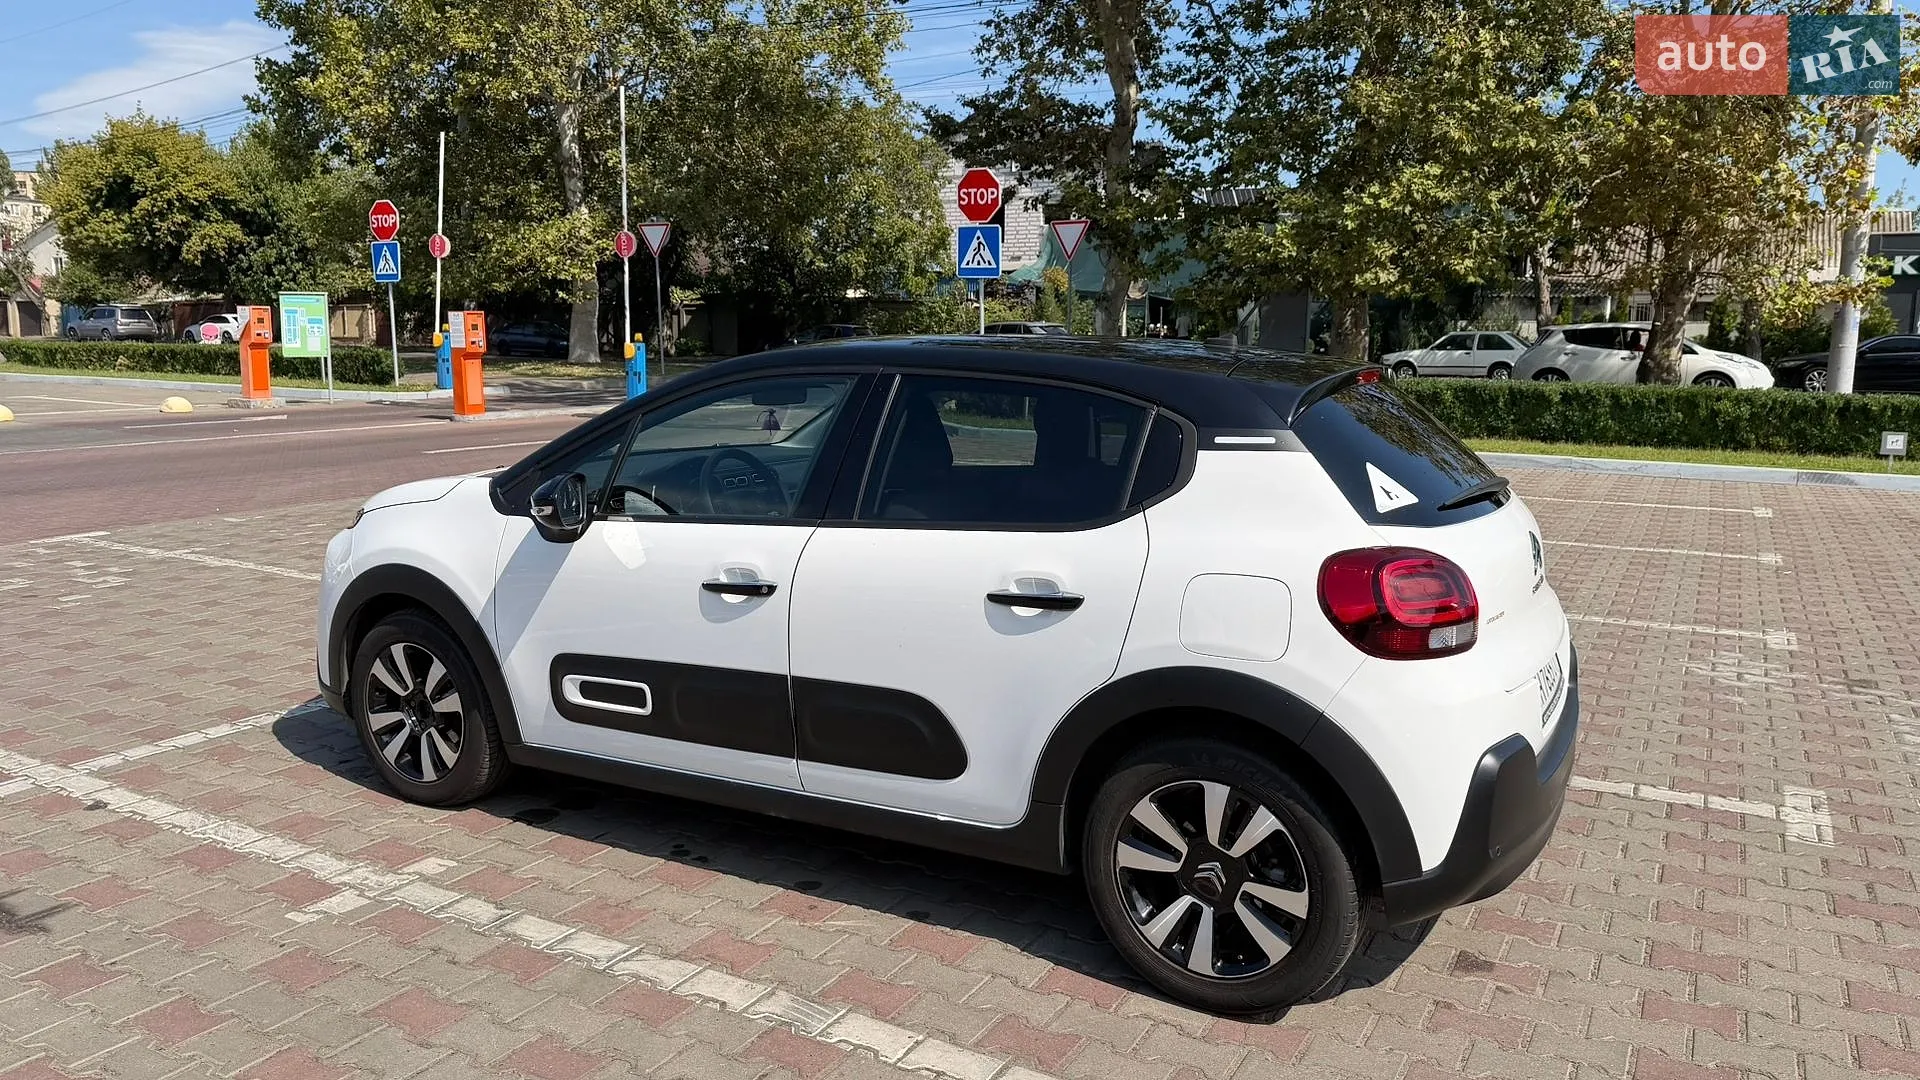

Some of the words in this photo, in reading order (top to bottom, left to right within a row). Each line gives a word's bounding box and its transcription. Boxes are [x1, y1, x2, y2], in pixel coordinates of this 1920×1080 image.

[960, 187, 998, 205] STOP
[371, 214, 396, 228] STOP
[620, 232, 628, 257] STOP
